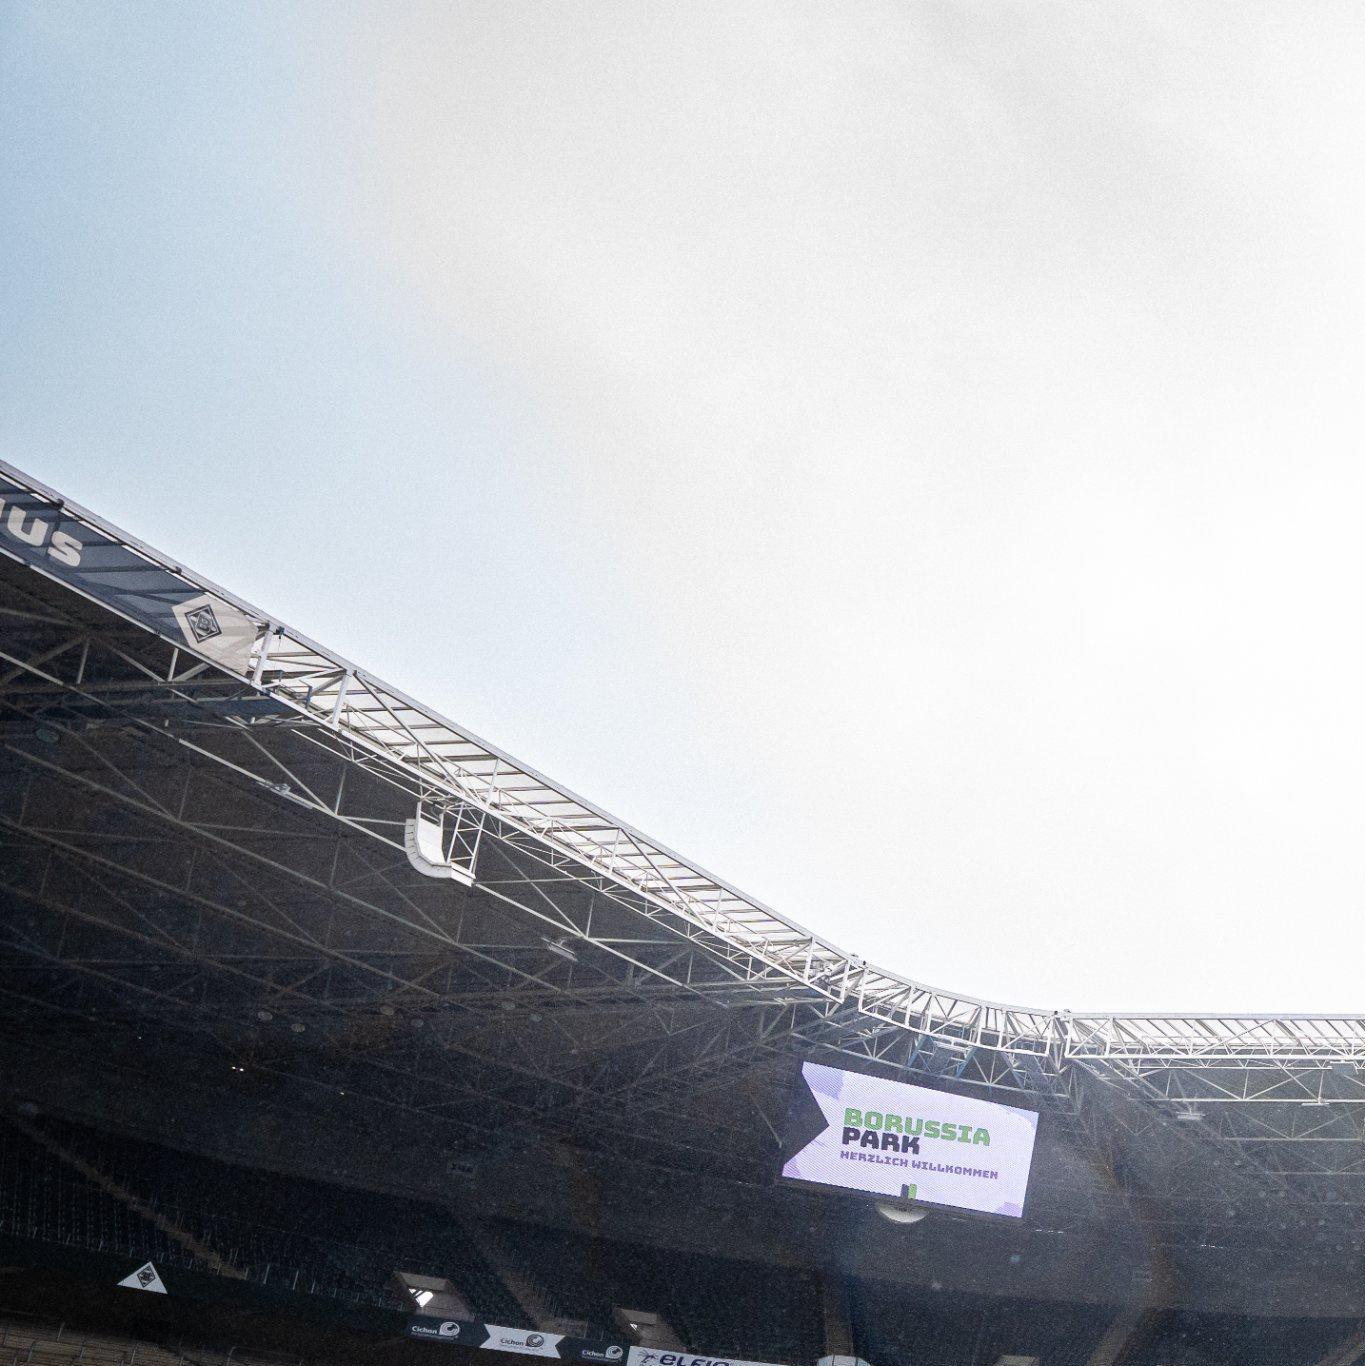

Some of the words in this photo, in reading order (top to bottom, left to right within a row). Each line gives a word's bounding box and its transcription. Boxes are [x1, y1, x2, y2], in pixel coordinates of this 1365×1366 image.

[0, 498, 83, 567] US
[841, 1126, 920, 1155] PARK
[843, 1107, 991, 1147] BORUSSIA
[840, 1151, 908, 1168] HERZLICH
[911, 1158, 999, 1180] WILLKOMMEN
